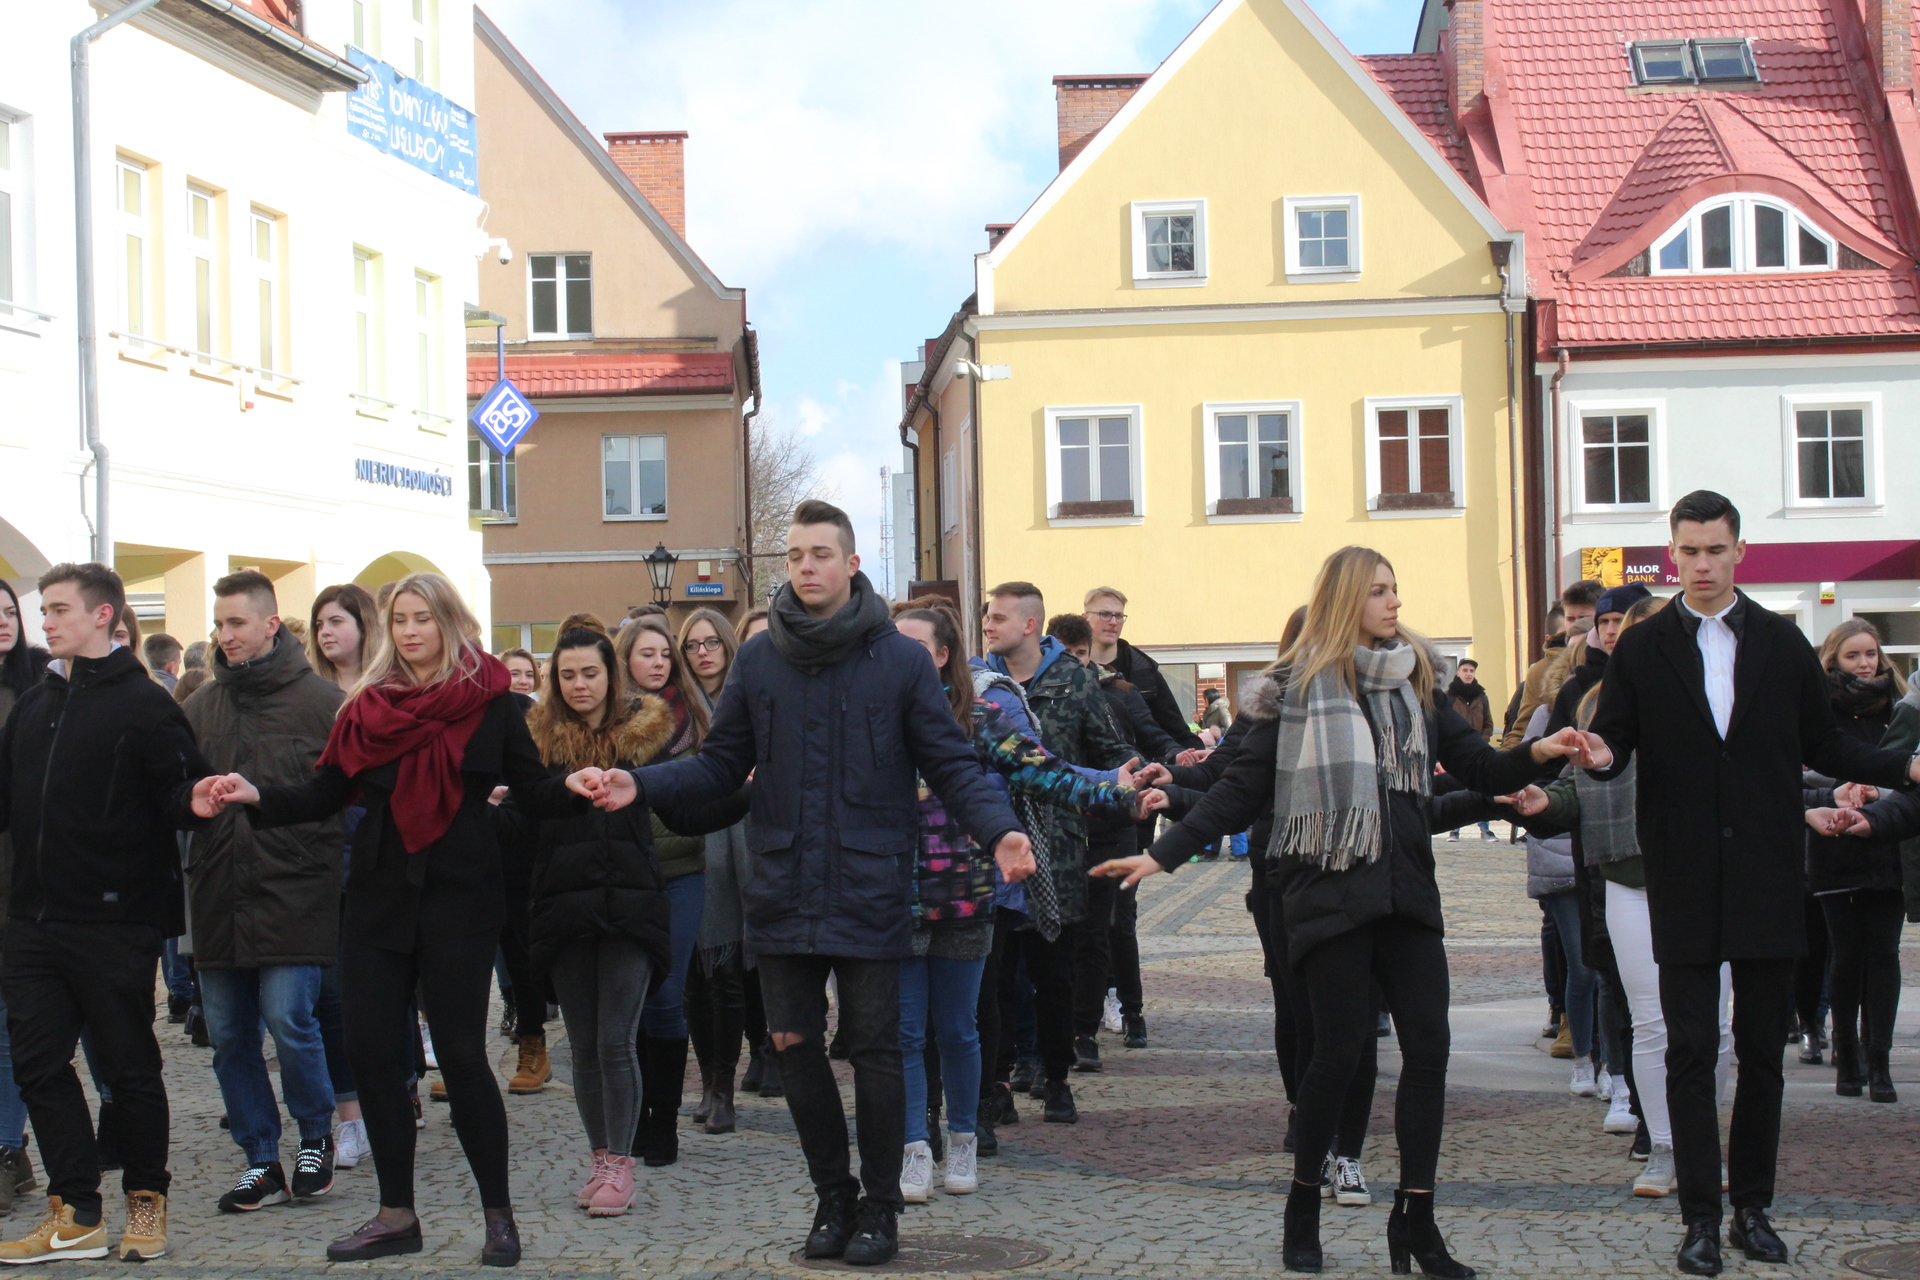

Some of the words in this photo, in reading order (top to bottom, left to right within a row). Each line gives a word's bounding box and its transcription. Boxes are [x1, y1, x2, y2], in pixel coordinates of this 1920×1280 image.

[355, 458, 452, 497] NIERUCHOMOŚCI
[1626, 565, 1660, 574] ALIOR
[1627, 574, 1655, 584] BANK
